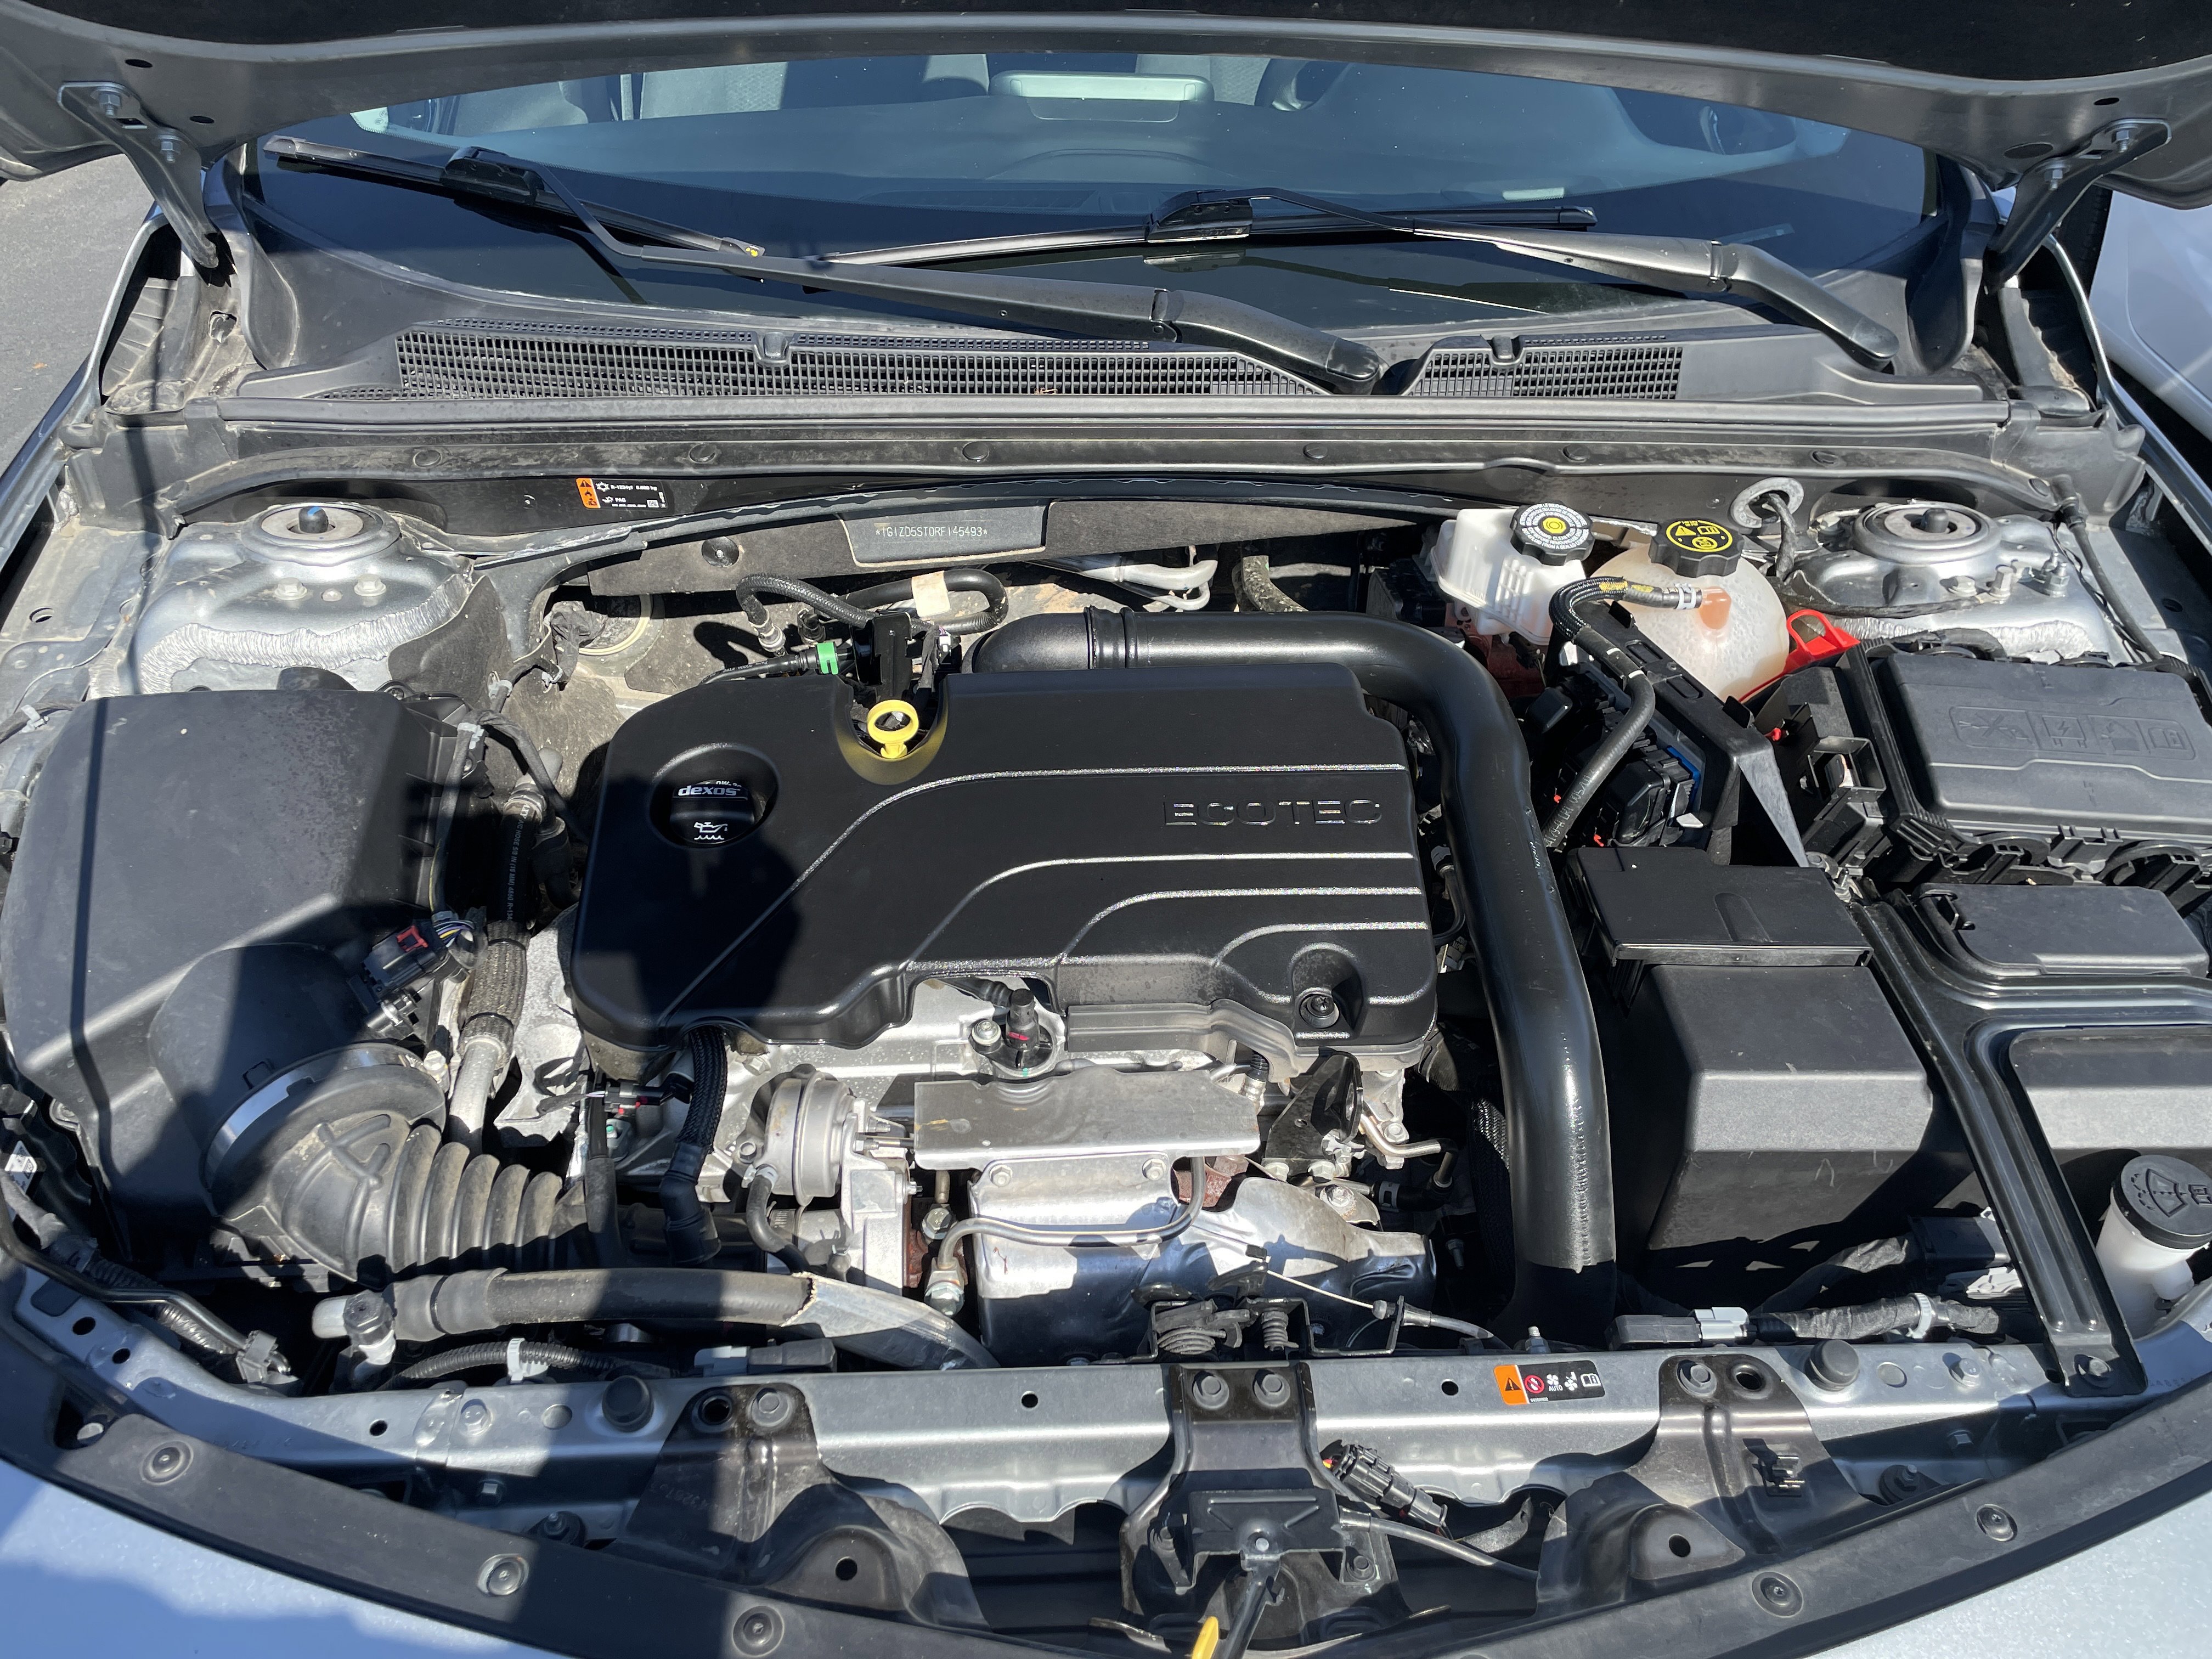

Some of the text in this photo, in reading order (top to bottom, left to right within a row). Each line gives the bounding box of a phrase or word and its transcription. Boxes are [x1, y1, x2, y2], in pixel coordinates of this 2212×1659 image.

[678, 785, 737, 797] dexos
[1163, 799, 1383, 826] ECOTEC
[512, 830, 522, 845] HOSE
